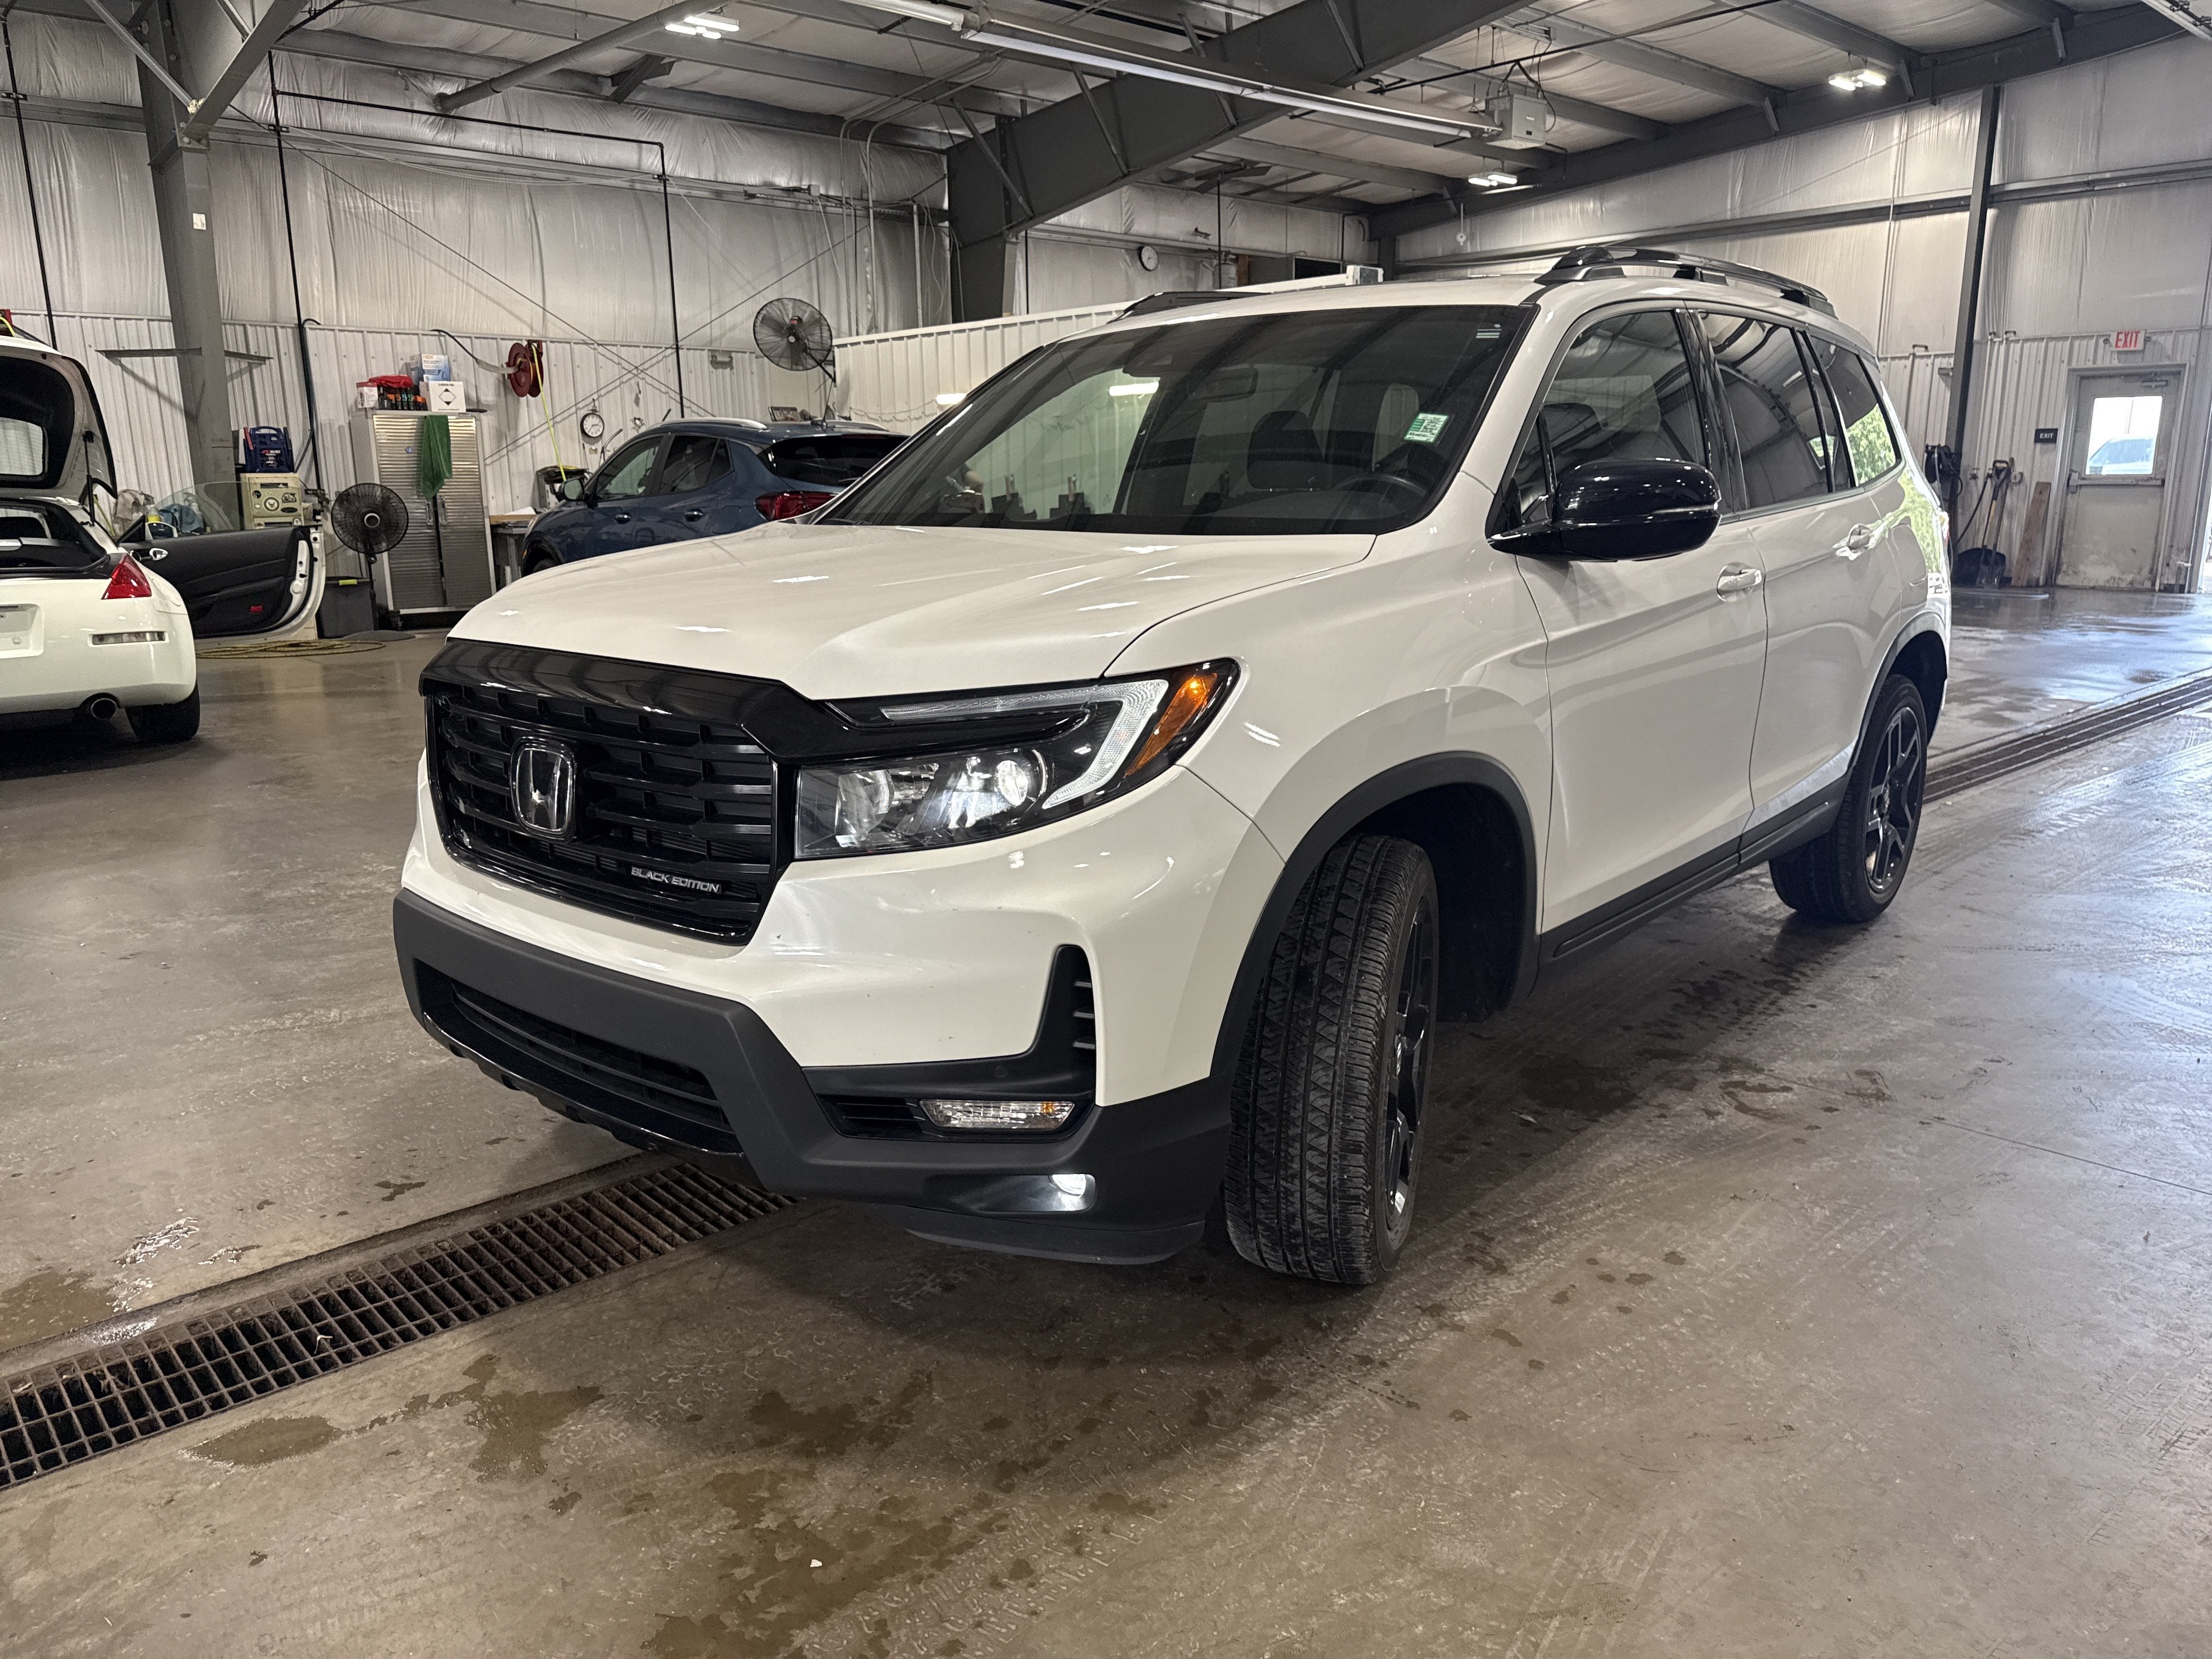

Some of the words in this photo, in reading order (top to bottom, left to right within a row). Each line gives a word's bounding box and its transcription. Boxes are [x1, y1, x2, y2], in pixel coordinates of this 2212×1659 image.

[2115, 331, 2140, 348] EXIT
[631, 866, 670, 883] BLACK
[671, 876, 720, 893] EDITION
